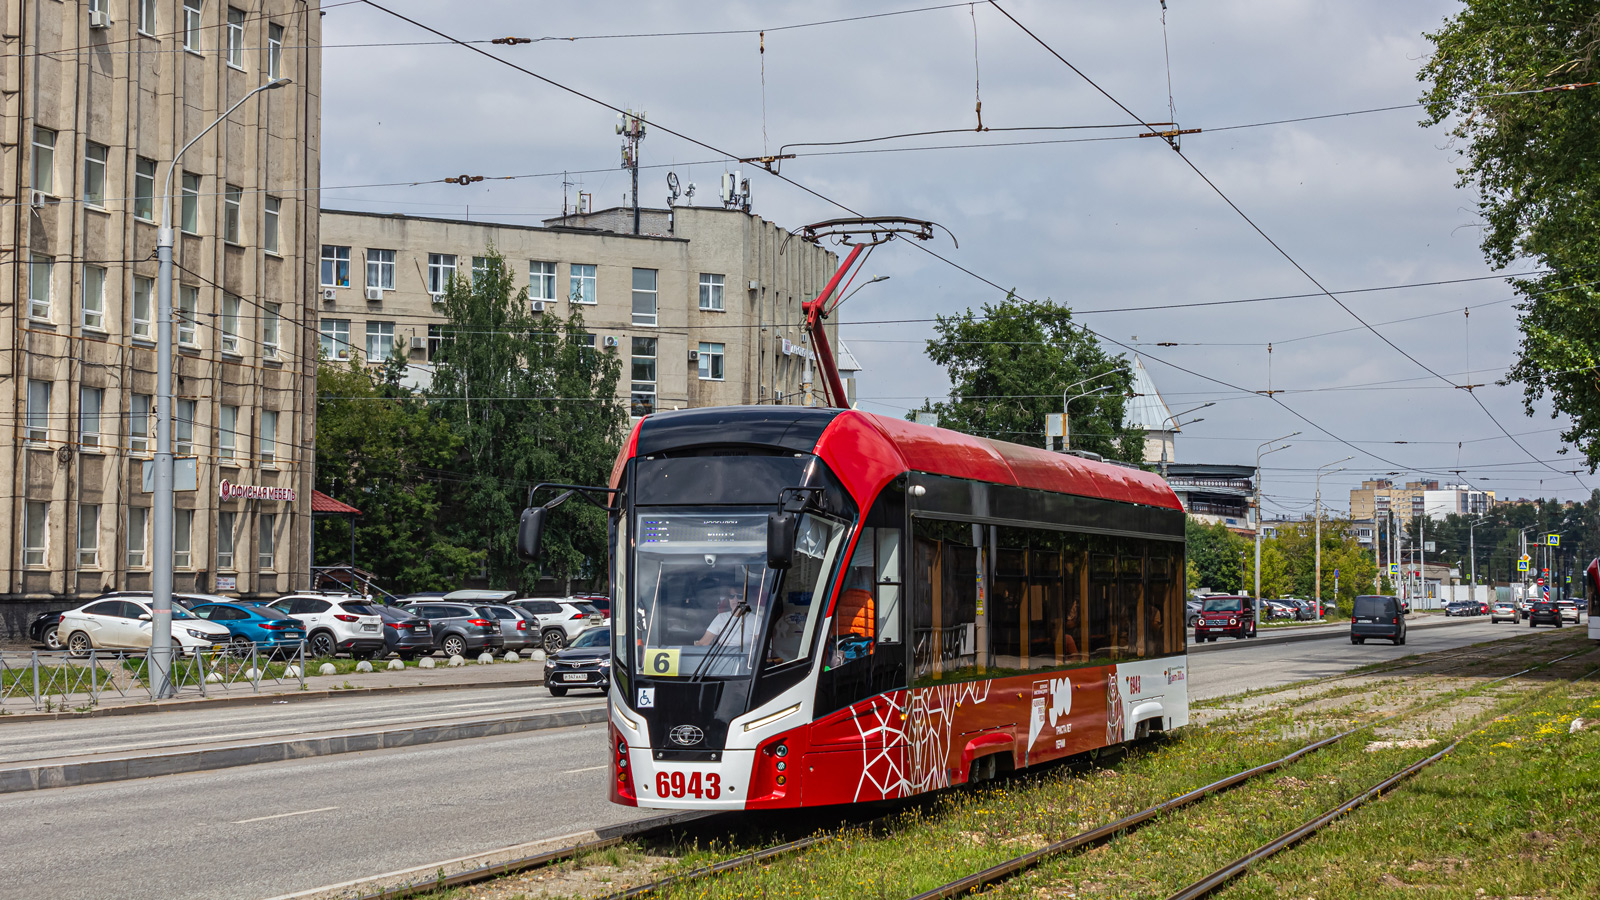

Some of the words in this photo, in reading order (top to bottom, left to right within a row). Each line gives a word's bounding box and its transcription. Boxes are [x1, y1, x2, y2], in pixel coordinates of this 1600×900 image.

[231, 485, 267, 499] ОФИСНАЯ
[268, 487, 296, 501] МЕБЕЛЬ
[653, 652, 670, 674] 6
[1130, 675, 1141, 695] 6943
[655, 771, 721, 800] 6943
